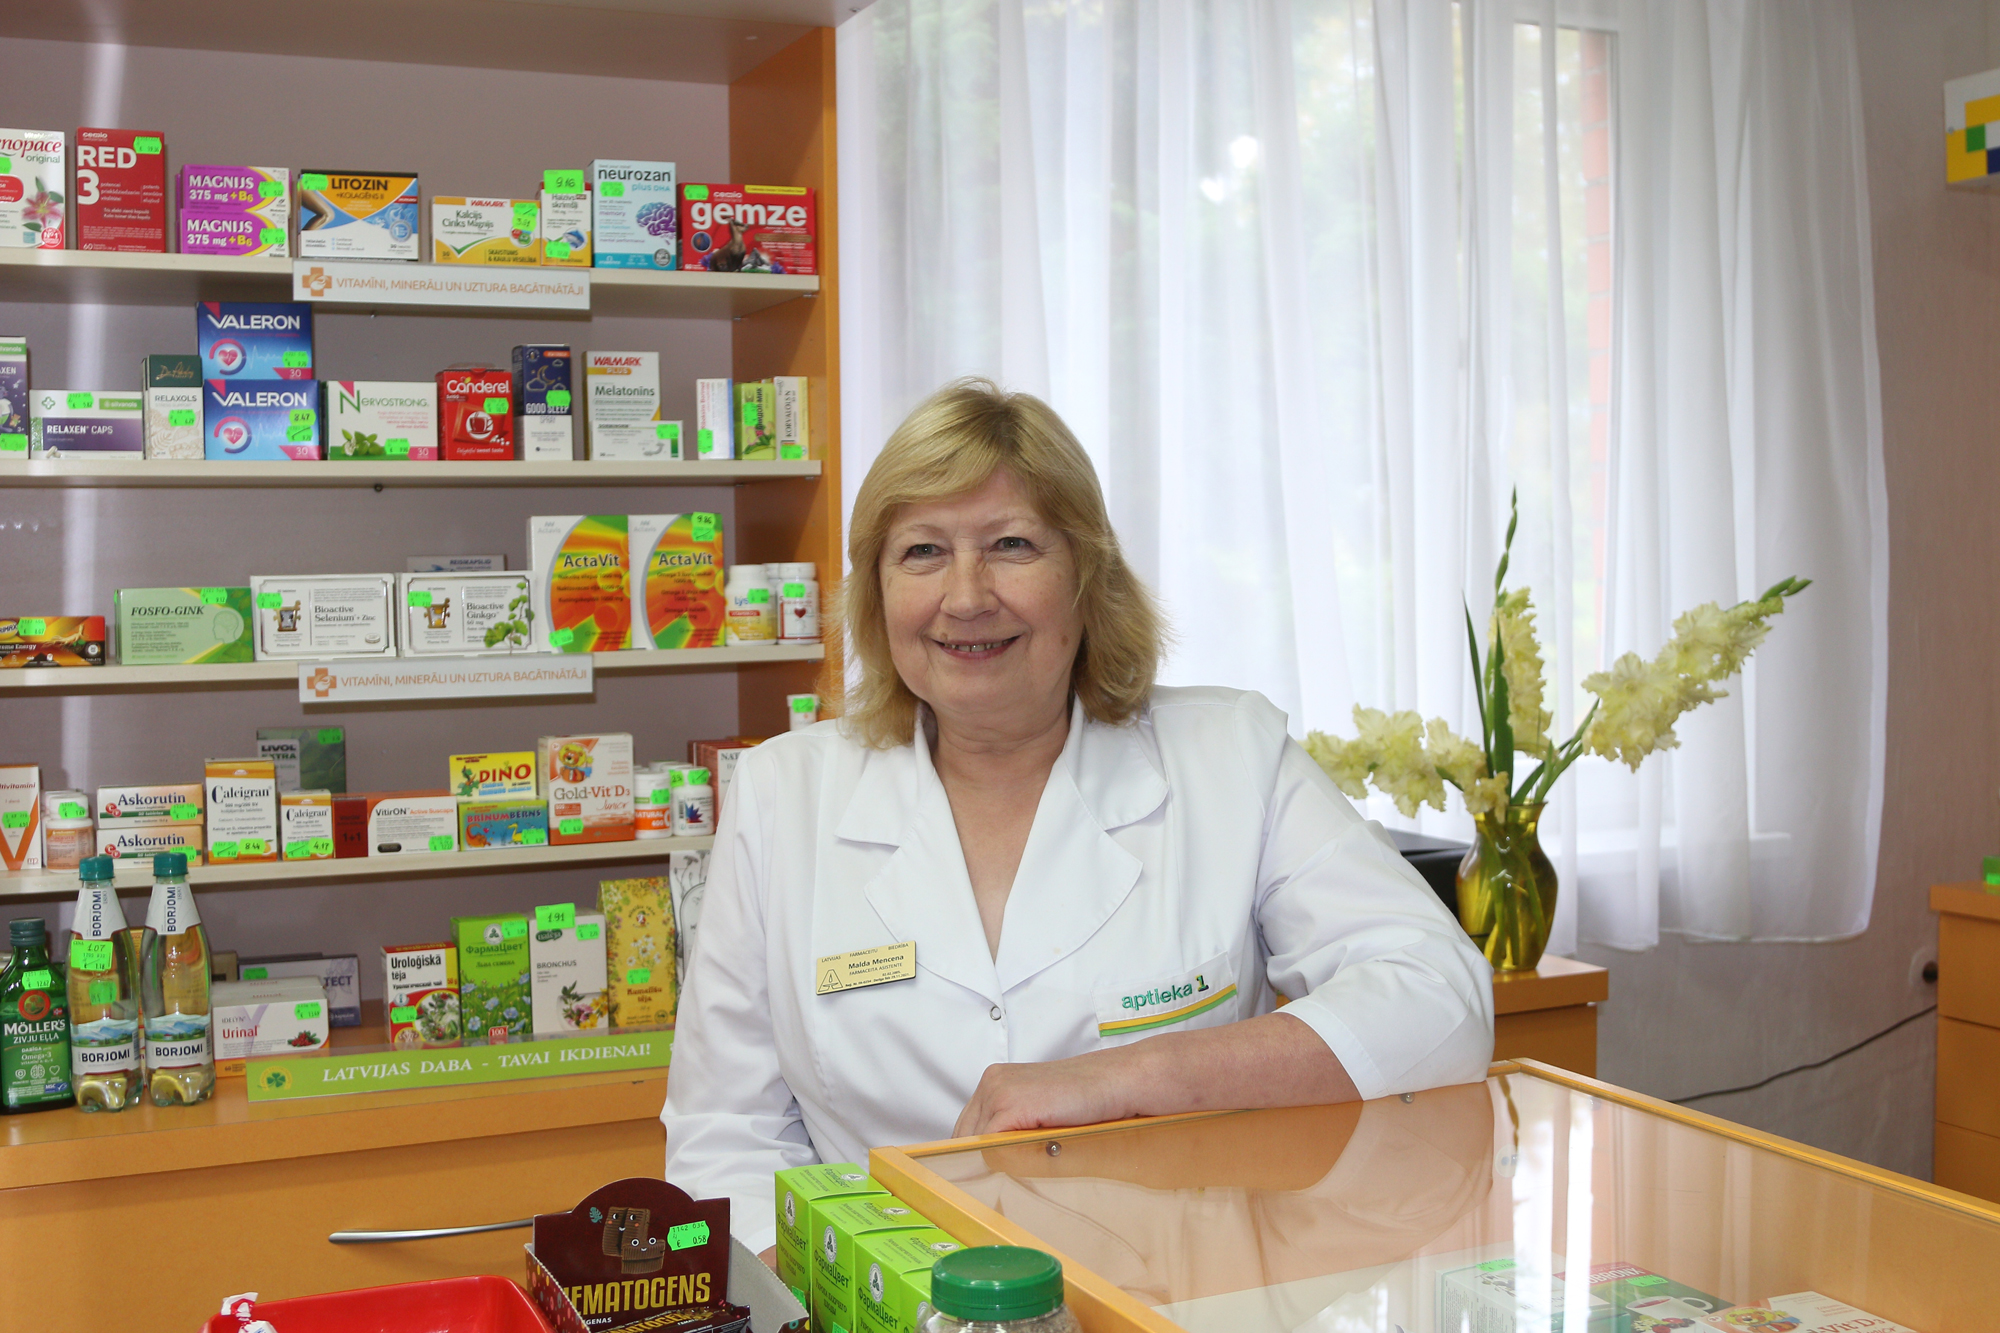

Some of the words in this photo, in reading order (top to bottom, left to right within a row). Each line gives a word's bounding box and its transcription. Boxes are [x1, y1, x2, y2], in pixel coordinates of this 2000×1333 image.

[0, 139, 62, 158] nopace
[26, 154, 61, 165] original
[78, 145, 137, 169] RED
[189, 174, 254, 189] MAGNIJS
[598, 169, 671, 182] neurozan
[77, 169, 100, 205] 3
[331, 178, 389, 191] LITOZIN
[631, 183, 651, 191] plus
[189, 190, 211, 200] 375
[214, 192, 228, 202] mg
[470, 199, 505, 207] WALMARK
[456, 210, 483, 220] Kalcijs
[691, 202, 807, 230] gemze
[187, 219, 253, 233] MAGNIJS
[442, 219, 466, 228] Cinks
[187, 234, 209, 244] 375
[212, 236, 226, 246] mg
[336, 277, 389, 290] VITAMĪNI,
[390, 279, 443, 291] MINERĀLI
[446, 281, 460, 291] UN
[464, 282, 507, 293] UZTURA
[510, 282, 584, 296] BAGĀTINĀTĀJI
[207, 314, 300, 329] VALERON
[593, 356, 642, 367] WALMARK
[289, 368, 302, 378] 30
[446, 380, 511, 394] Canderel
[595, 385, 655, 396] Melatonins
[212, 391, 308, 407] VALERON
[525, 402, 546, 414] GOOD
[46, 425, 86, 434] RELAXEN
[91, 425, 113, 434] CAPS
[295, 446, 309, 456] 30
[417, 448, 429, 456] 30
[563, 554, 620, 568] ActaVit
[658, 553, 713, 566] ActaVit
[131, 606, 205, 617] FOSFO-GINK
[314, 605, 355, 613] Bioactive
[466, 602, 505, 610] Bioactive
[314, 614, 354, 622] Selenium
[466, 611, 497, 620] Ginkgo
[340, 673, 393, 687] VITAMĪNI,
[395, 671, 447, 685] MINERĀLI
[450, 673, 465, 683] UN
[468, 671, 511, 683] UZTURA
[514, 668, 586, 681] BAGĀTINĀTĀJI
[479, 763, 532, 783] DINO
[118, 792, 185, 806] Askorutin
[211, 785, 270, 804] Calcigran
[554, 785, 611, 800] Gold-Vit
[286, 807, 328, 821] Calcigran
[375, 808, 407, 816] VitirON
[117, 833, 185, 847] Askorutin
[92, 889, 102, 937] BORJOMI
[167, 886, 176, 932] BORJOMI
[465, 942, 523, 954] ФармаЦвет
[821, 955, 841, 963] LATVIJAS
[849, 948, 879, 957] FARMACEITU
[888, 943, 909, 951] BIEDRĪBA
[391, 954, 442, 969] Uroloģiskā
[536, 960, 577, 969] BRONCHUS
[848, 960, 871, 970] Malda
[872, 955, 905, 965] Mencena
[849, 967, 878, 976] FARMACEITA
[878, 962, 903, 971] ASISTENTE
[391, 971, 407, 981] tēja
[638, 995, 652, 1003] tēja
[1121, 983, 1193, 1011] aptieka
[1195, 975, 1209, 992] 1
[4, 1019, 66, 1036] MÖLLER'S
[222, 1025, 259, 1039] Urinal
[491, 1028, 505, 1036] 100
[13, 1034, 38, 1044] ZIVJU
[39, 1032, 60, 1043] EĻĻA
[21, 1052, 52, 1060] Omega-3
[81, 1049, 130, 1063] BORJOMI
[155, 1044, 203, 1057] BORJOMI
[322, 1062, 411, 1083] LATVIJAS
[419, 1058, 473, 1074] DABA
[498, 1051, 550, 1068] TAVAI
[560, 1043, 651, 1063] IKDIENAI!
[813, 1249, 850, 1289] ФармаЦвет
[857, 1286, 900, 1330] ФармаЦвет
